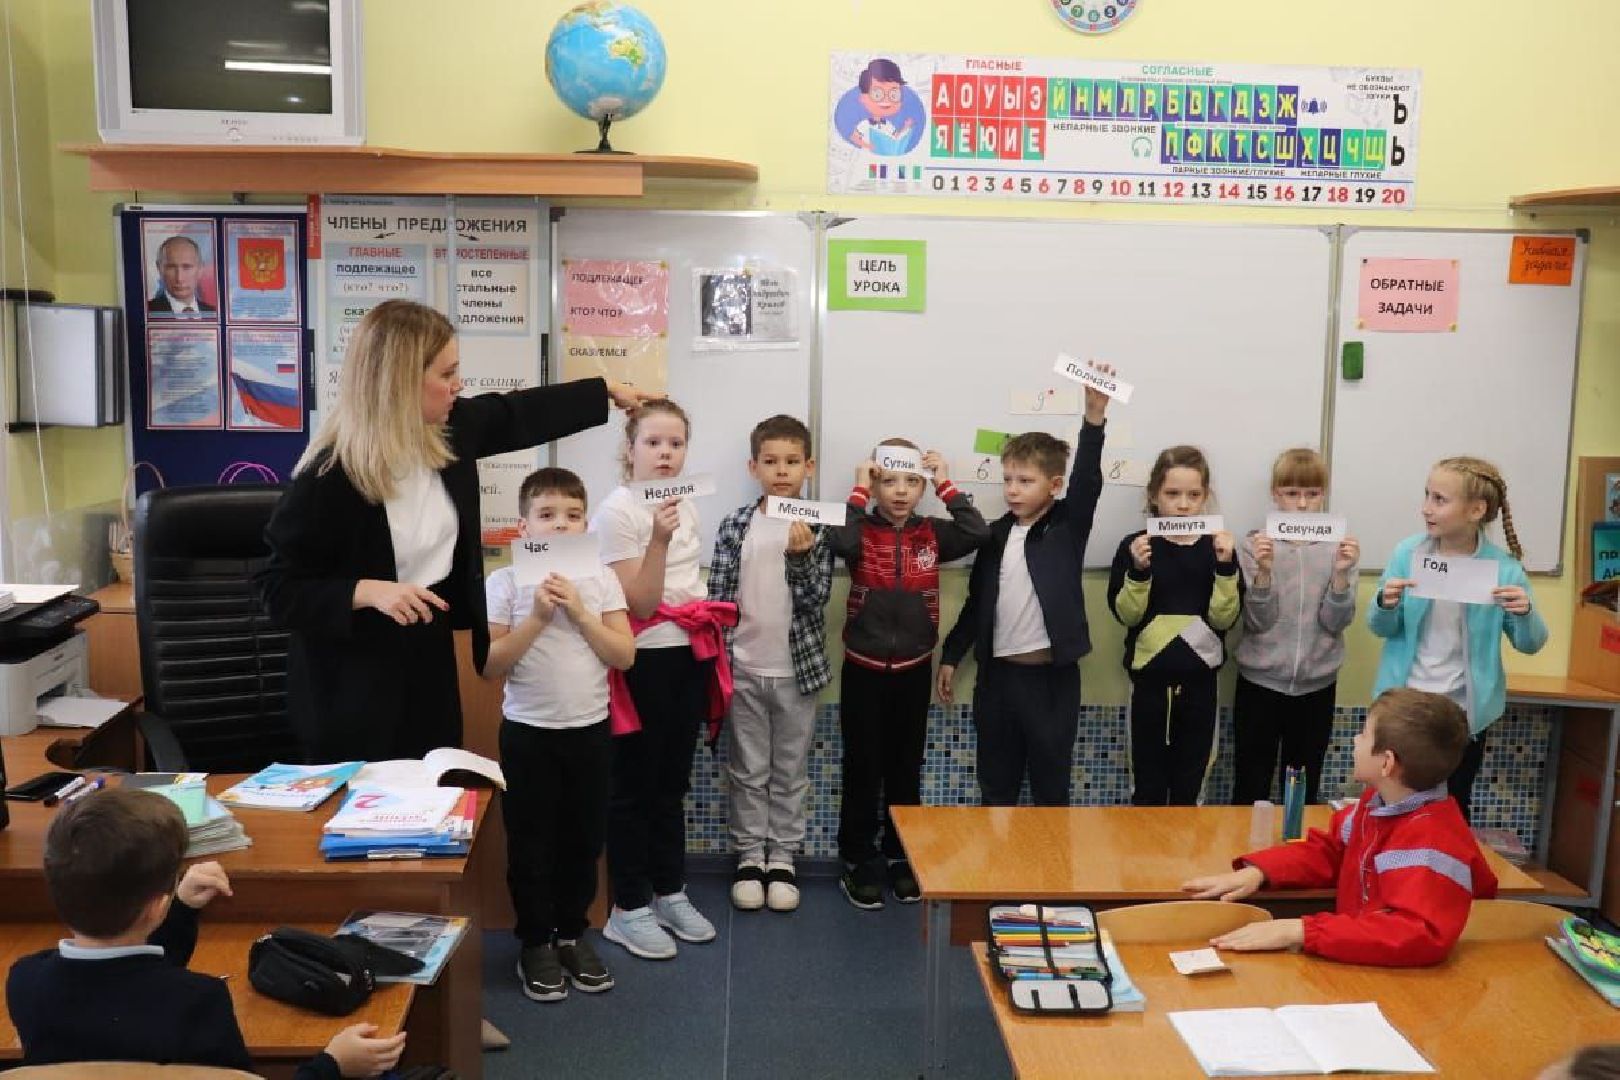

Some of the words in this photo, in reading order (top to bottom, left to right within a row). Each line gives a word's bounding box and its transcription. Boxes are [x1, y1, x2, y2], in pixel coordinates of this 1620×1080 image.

[966, 59, 1023, 71] ГЛАСНЫЕ
[1142, 65, 1214, 77] СОГЛАСНЫЕ
[1053, 123, 1108, 133] НЕПАРНЫЕ
[1111, 124, 1156, 134] ЗВОНКИЕ
[1172, 166, 1208, 175] ПАРНЫЕ
[1301, 170, 1347, 178] НЕПАРНЫЕ
[1350, 171, 1382, 180] ГЛУХИЕ
[933, 176, 944, 190] 0
[951, 176, 959, 190] 1
[967, 176, 978, 191] 2
[984, 177, 995, 191] 3
[1003, 177, 1013, 192] 4
[1020, 178, 1031, 193] 5
[1039, 178, 1049, 193] 6
[1057, 179, 1067, 194] 7
[1074, 179, 1085, 194] 8
[1092, 180, 1103, 195] 9
[1111, 180, 1131, 195] 10
[1138, 182, 1156, 196] 11
[1163, 182, 1184, 197] 12
[1192, 183, 1211, 198] 13
[1219, 183, 1240, 199] 14
[1247, 184, 1267, 199] 15
[1274, 185, 1295, 200] 16
[1302, 186, 1321, 201] 17
[1328, 187, 1348, 202] 18
[1355, 188, 1375, 203] 19
[1382, 188, 1405, 204] 20
[327, 216, 387, 230] ЧЛЕНЫ
[349, 247, 402, 258] ГЛАВНЫЕ
[433, 248, 530, 260] ВТОСТЕПЕННЫЕ
[336, 264, 416, 276] подлежащее
[471, 269, 492, 278] все
[859, 260, 897, 274] ЦЕЛЬ
[457, 283, 517, 292] стальные
[853, 280, 901, 293] УРОКА
[1370, 278, 1445, 292] ОБРАТНЫЕ
[462, 300, 502, 308] члены
[1378, 302, 1433, 315] ЗАДАЧИ
[570, 306, 595, 316] КТО?
[598, 308, 623, 318] ЧТО?
[457, 315, 524, 324] дложения
[1066, 362, 1117, 393] Полчаса
[883, 456, 915, 470] Сутки
[645, 484, 695, 500] Неделя
[777, 502, 820, 519] Месяц
[1158, 519, 1206, 532] Минута
[1278, 522, 1332, 536] Секунда
[524, 541, 549, 554] Час
[1423, 557, 1448, 574] Год
